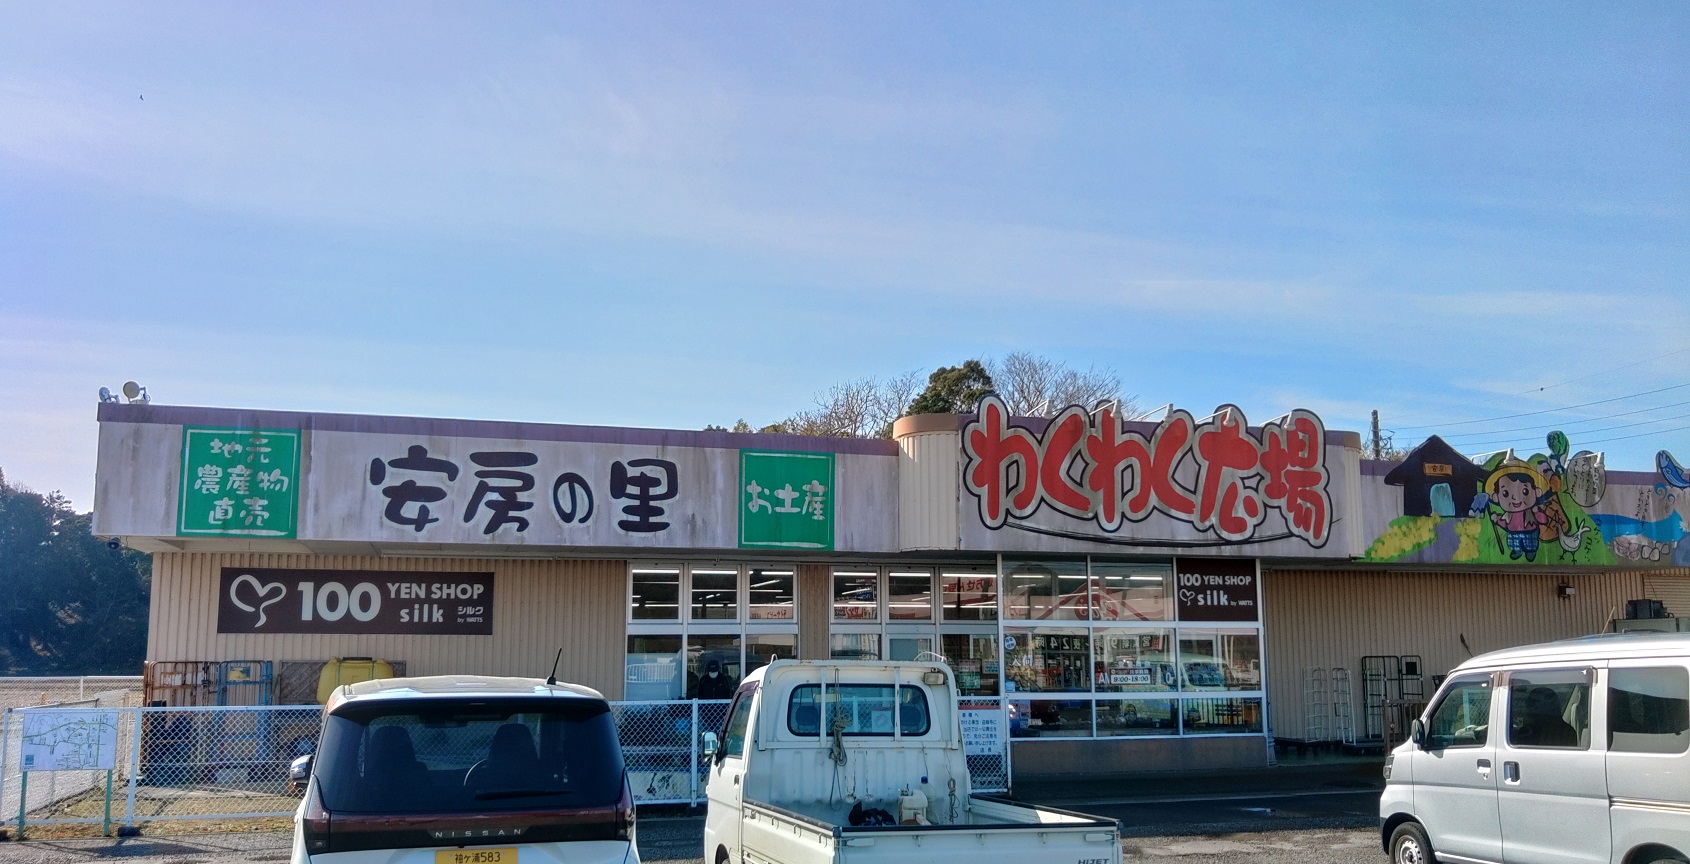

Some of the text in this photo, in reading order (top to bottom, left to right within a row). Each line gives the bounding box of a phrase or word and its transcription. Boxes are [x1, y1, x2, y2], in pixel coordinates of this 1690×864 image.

[210, 438, 271, 464] 地元
[194, 464, 289, 494] 農産物
[967, 398, 1329, 544] わくわく広場
[369, 444, 678, 535] 安房の里
[745, 479, 827, 521] お土産
[209, 497, 270, 526] 直売
[1179, 573, 1252, 586] 100 YEN SHOP
[297, 581, 484, 622] 100 YEN SHOP
[457, 606, 484, 615] シルク
[1197, 590, 1228, 606] silk
[400, 604, 444, 622] silk
[1113, 675, 1149, 683] 9:00-18:00
[435, 829, 521, 838] NISSAN
